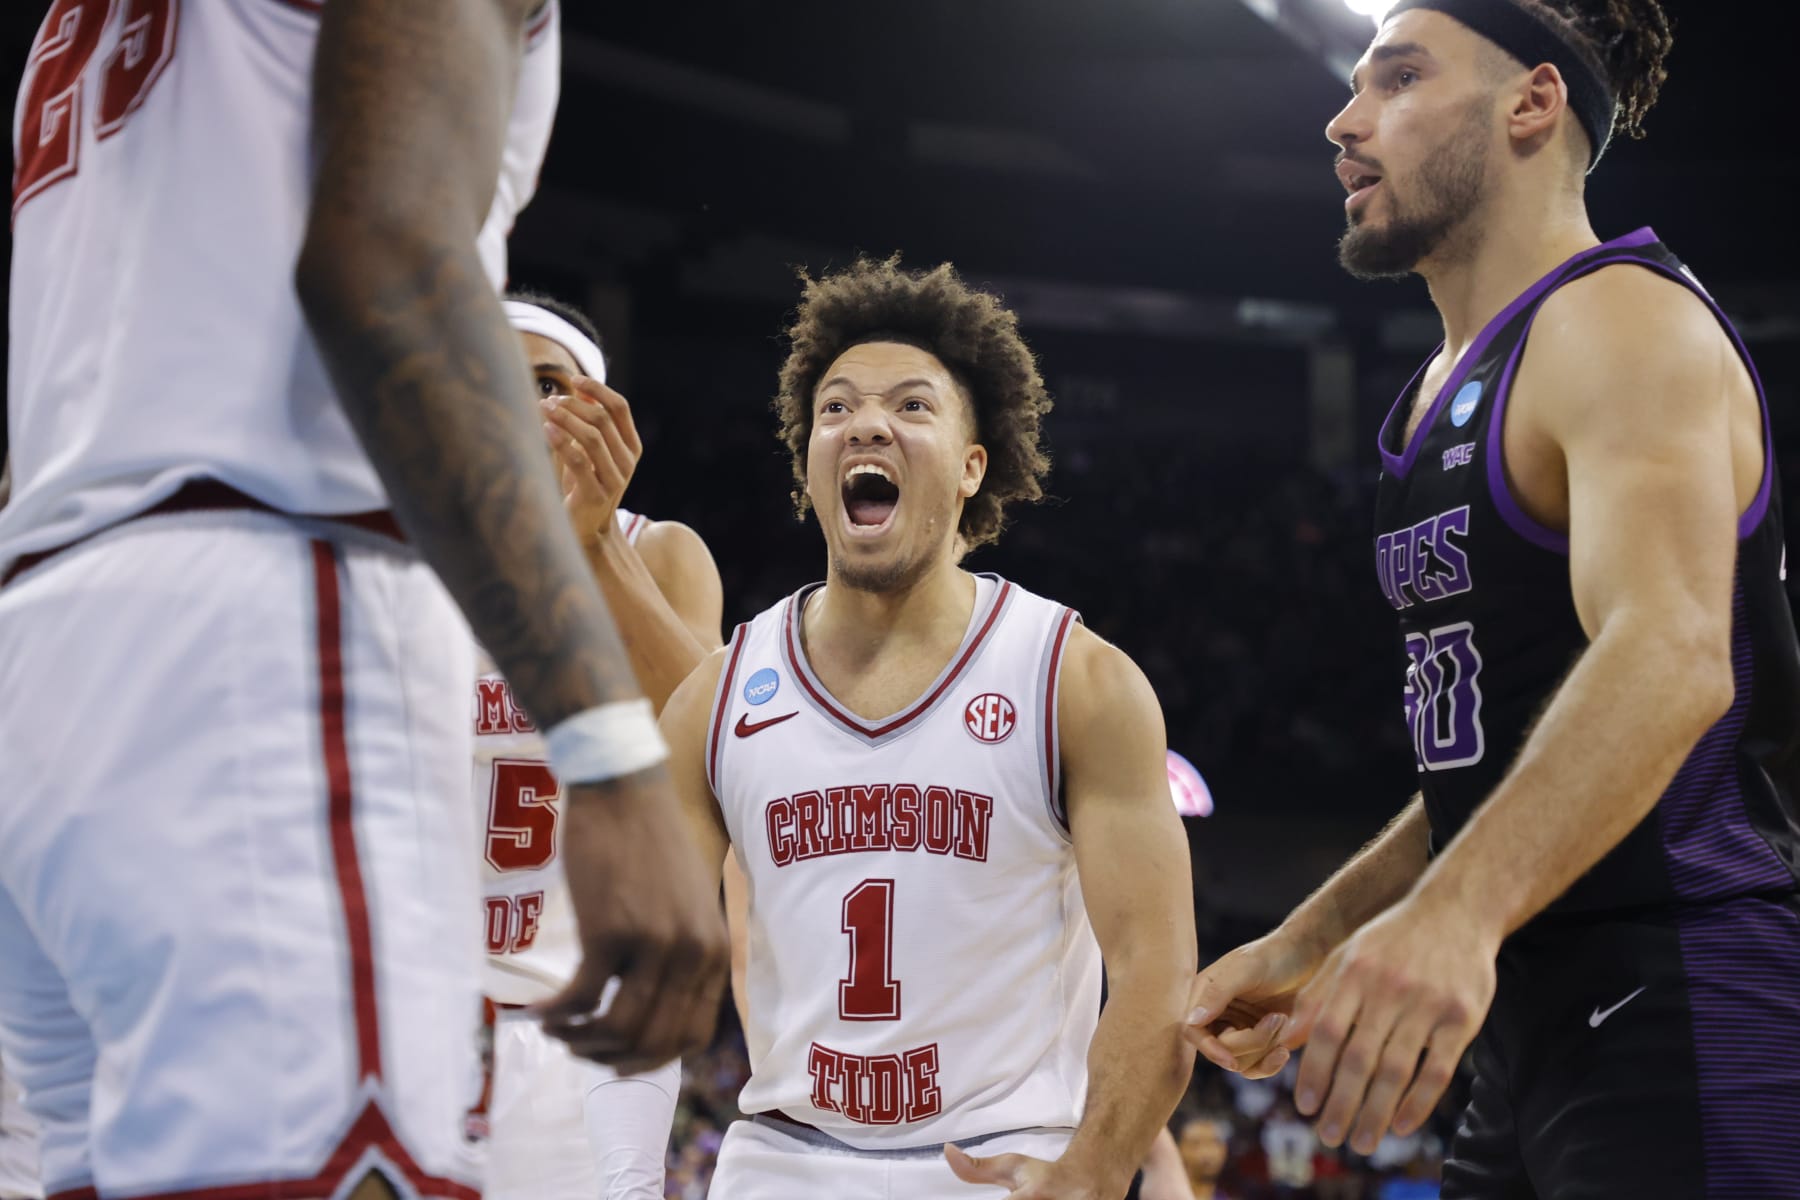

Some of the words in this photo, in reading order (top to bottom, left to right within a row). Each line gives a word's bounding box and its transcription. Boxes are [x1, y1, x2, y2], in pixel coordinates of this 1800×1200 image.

[1442, 441, 1476, 471] WAC
[966, 693, 1015, 741] SEC
[485, 758, 562, 873] 5
[766, 784, 993, 867] CRIMSON
[484, 890, 544, 955] DE
[838, 879, 901, 1020] 1
[808, 1042, 942, 1125] TIDE
